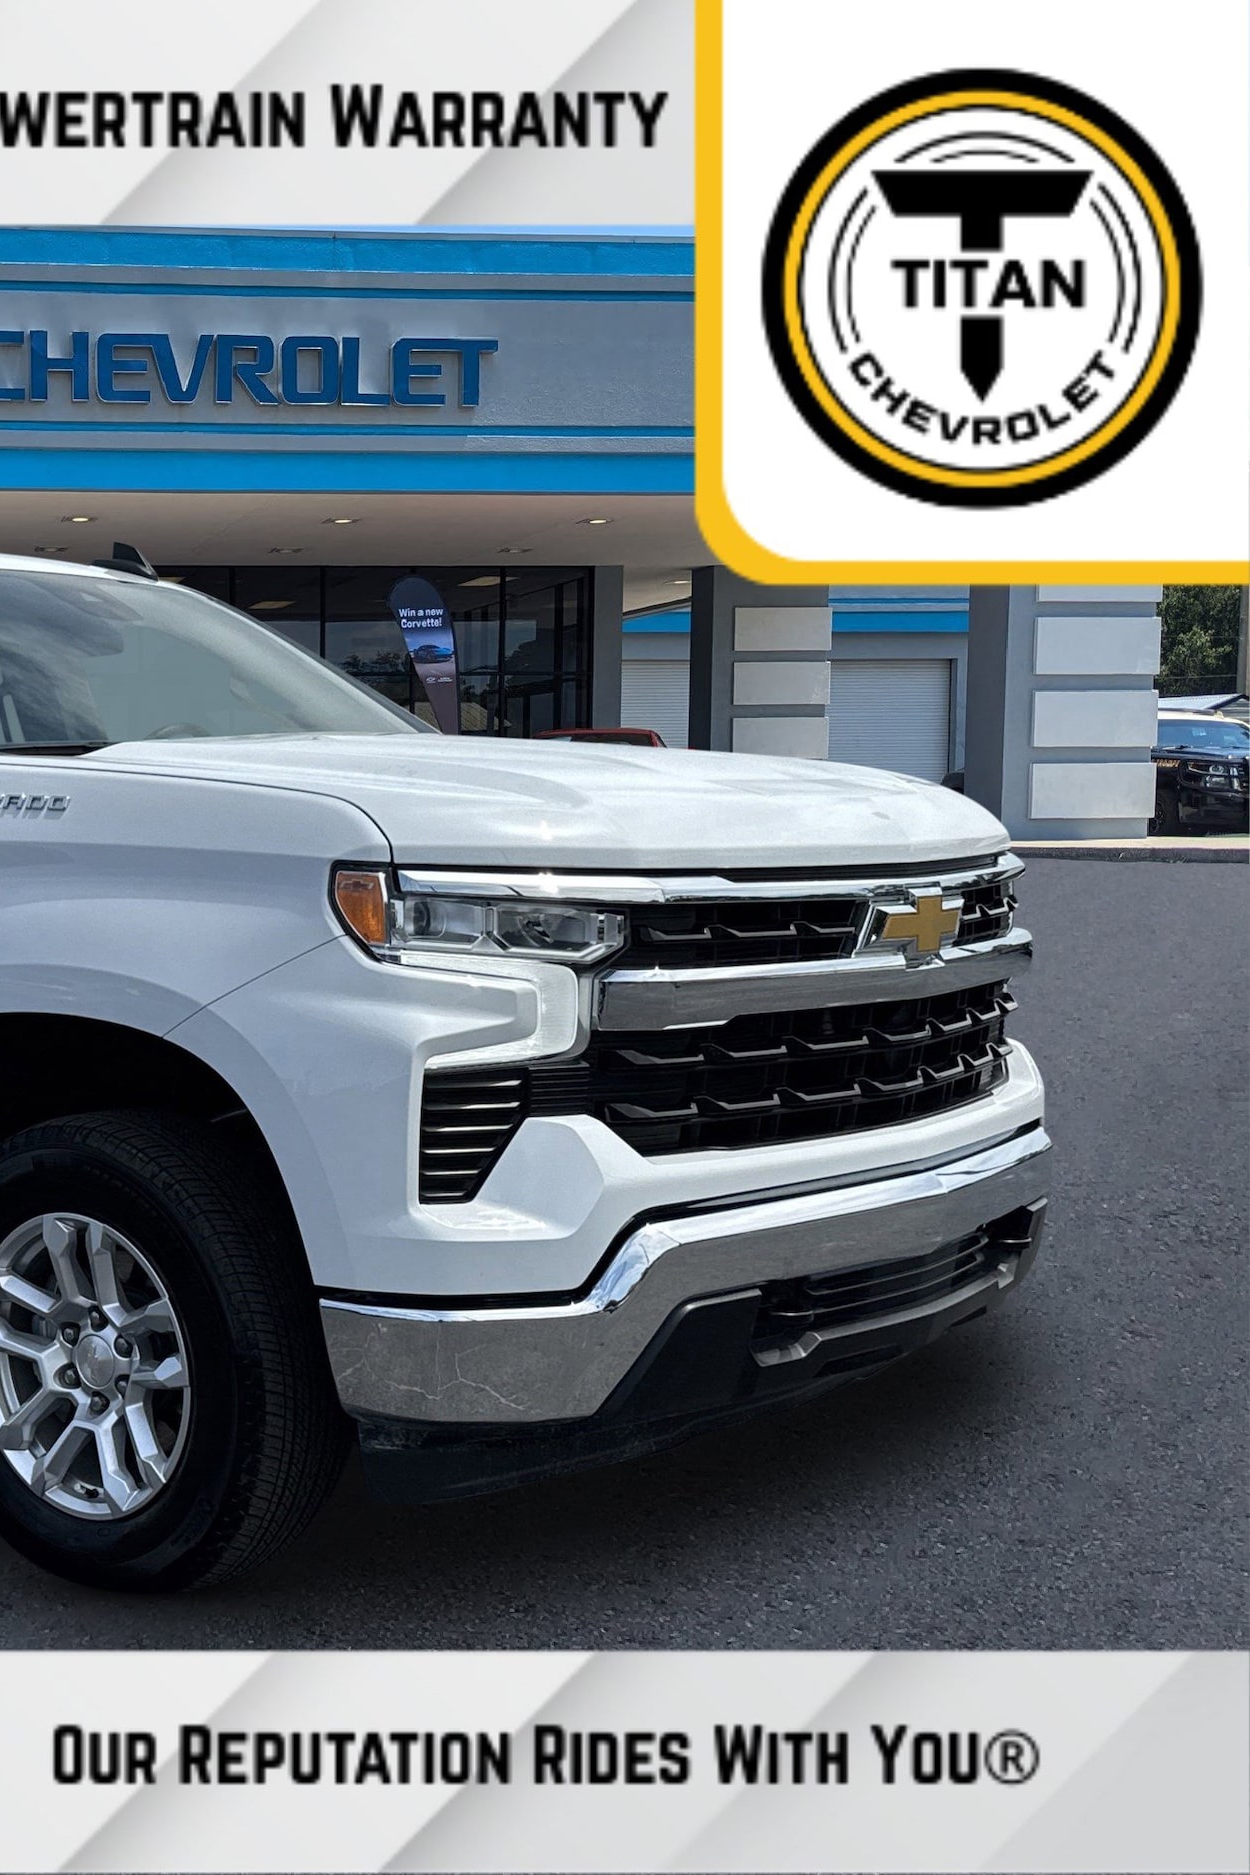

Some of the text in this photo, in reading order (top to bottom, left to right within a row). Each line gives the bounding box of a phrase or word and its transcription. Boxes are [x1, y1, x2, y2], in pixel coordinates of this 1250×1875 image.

[398, 608, 444, 618] Win a new
[400, 617, 443, 629] Corvette!
